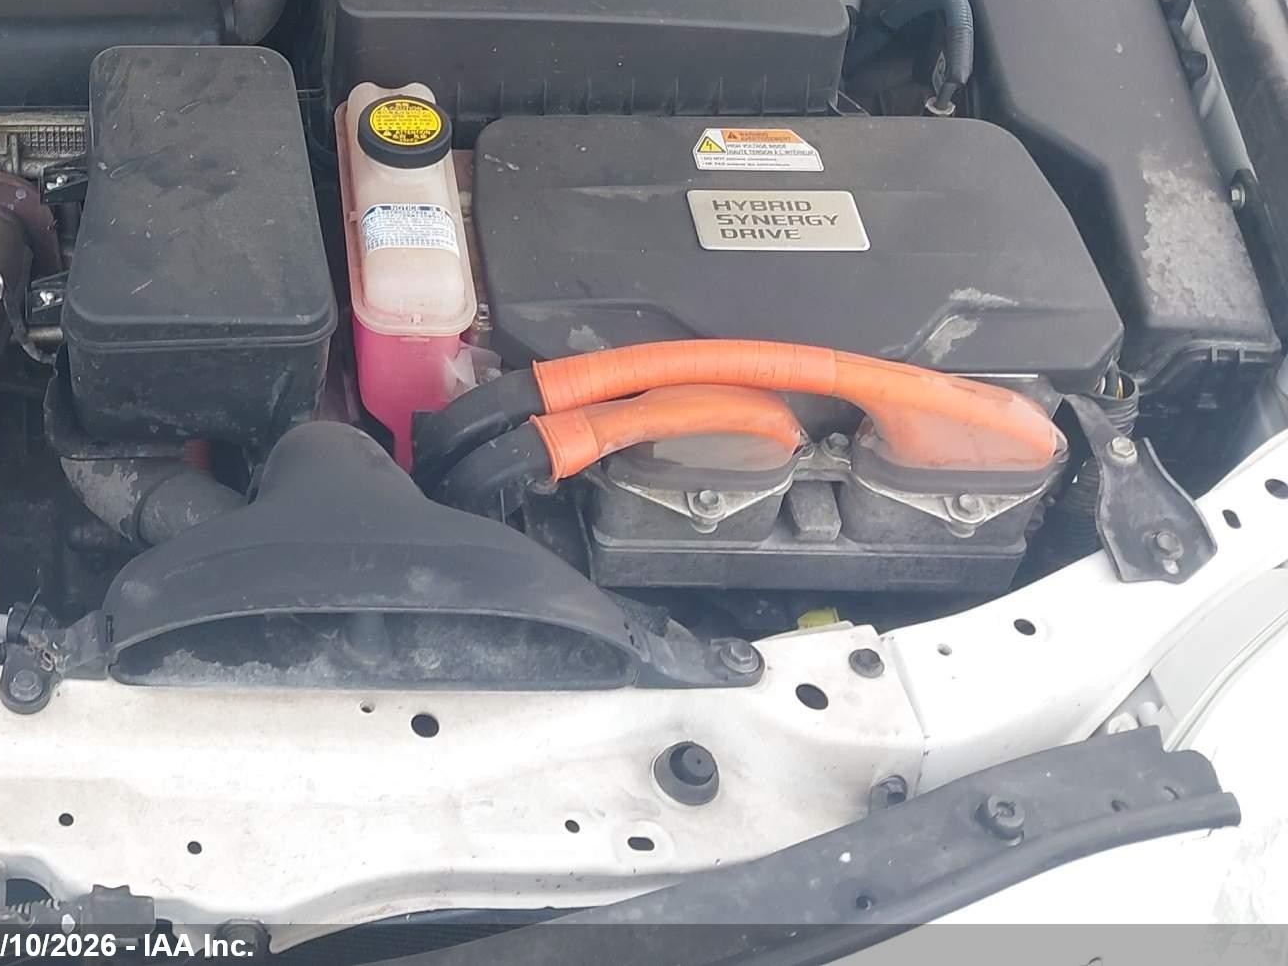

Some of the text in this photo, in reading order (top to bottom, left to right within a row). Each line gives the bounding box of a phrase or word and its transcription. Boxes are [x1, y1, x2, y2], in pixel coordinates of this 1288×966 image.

[712, 200, 812, 211] HYBRID
[716, 214, 838, 225] SYNERGY
[720, 229, 801, 239] DRIVE
